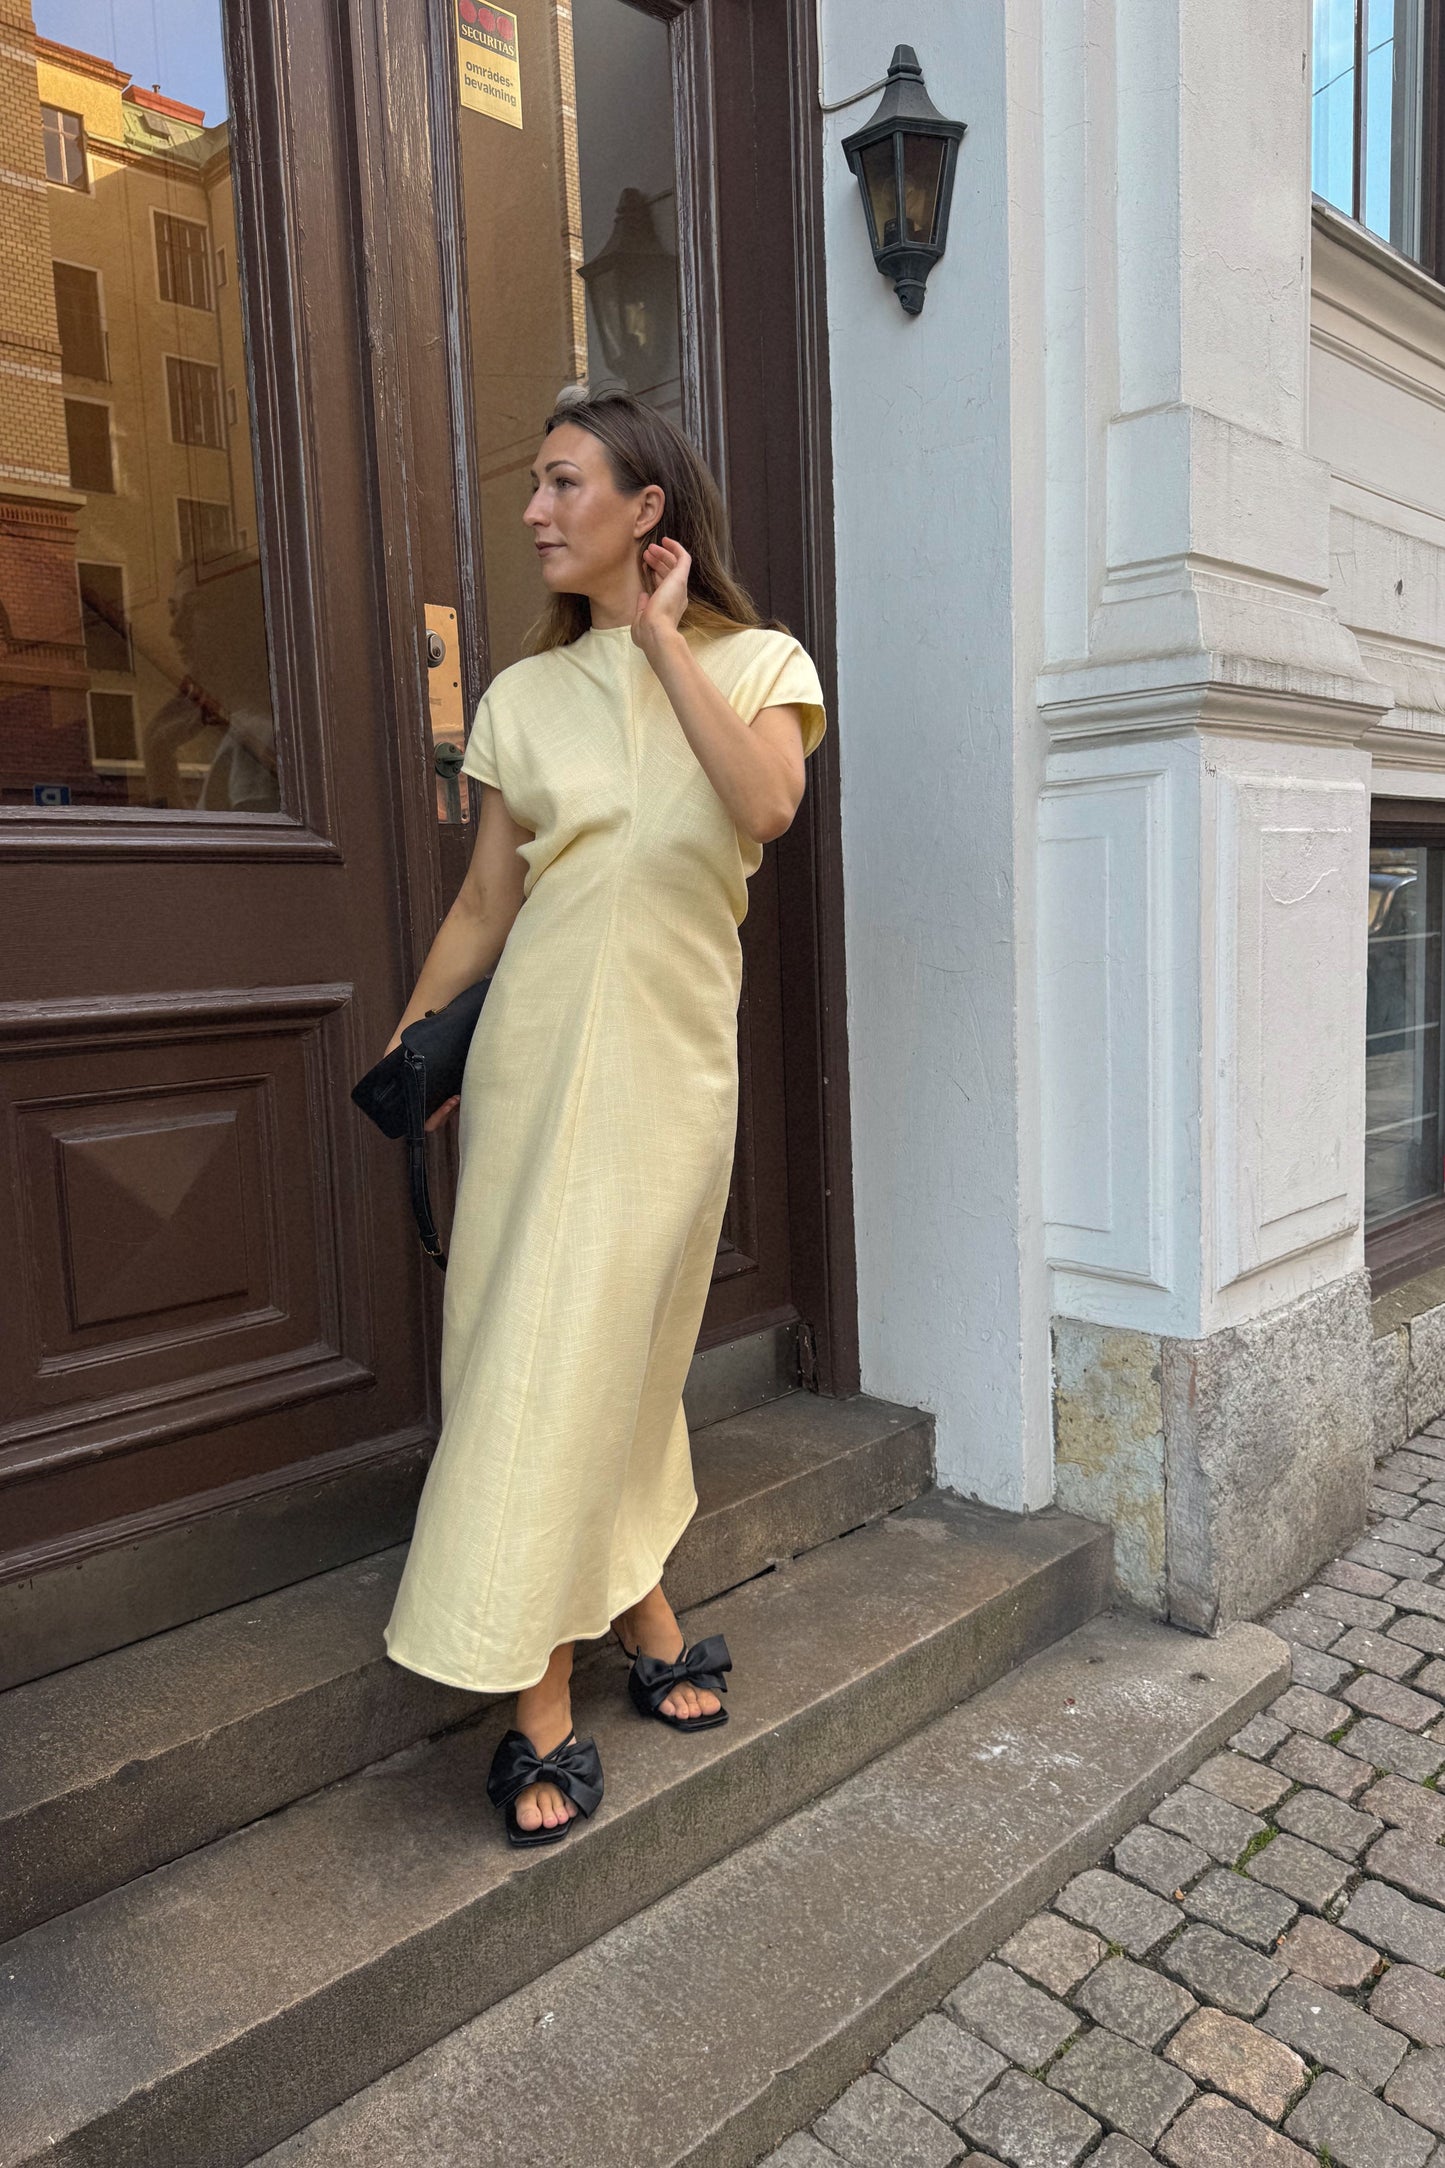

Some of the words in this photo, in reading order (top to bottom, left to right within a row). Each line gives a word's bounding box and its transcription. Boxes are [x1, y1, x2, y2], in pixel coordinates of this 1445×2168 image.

[461, 24, 515, 56] SECURITAS
[465, 61, 514, 87] områdes-
[464, 74, 516, 107] bevakning
